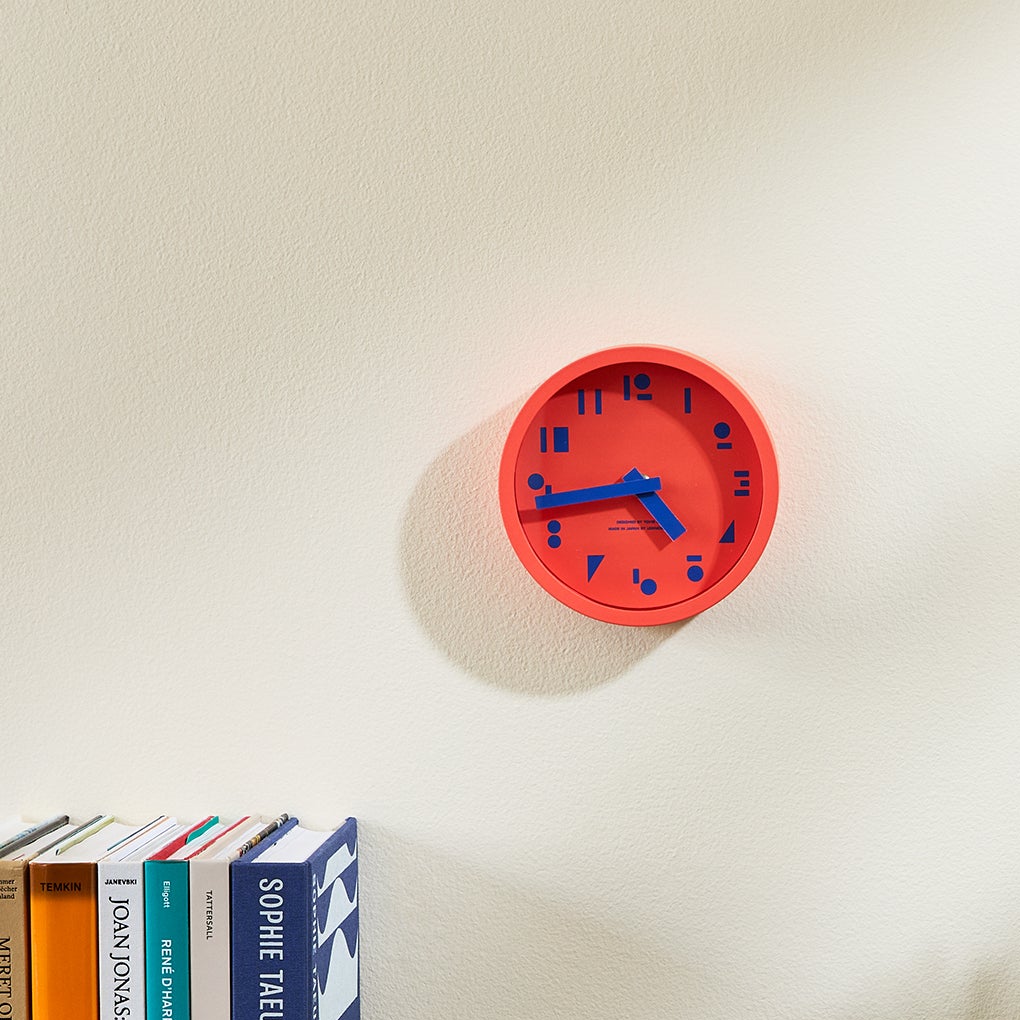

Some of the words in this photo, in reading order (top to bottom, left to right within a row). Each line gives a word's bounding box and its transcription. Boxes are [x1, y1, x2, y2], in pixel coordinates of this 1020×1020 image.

[40, 882, 82, 892] TEMKIN
[104, 878, 137, 886] JANEVSKI
[162, 880, 171, 908] Elligott
[109, 897, 130, 950] JOAN
[205, 890, 213, 940] TATTERSALL
[259, 878, 284, 961] SOPHIE
[0, 937, 12, 999] MERET
[161, 939, 175, 975] RENÉ
[110, 953, 131, 1020] JONAS:
